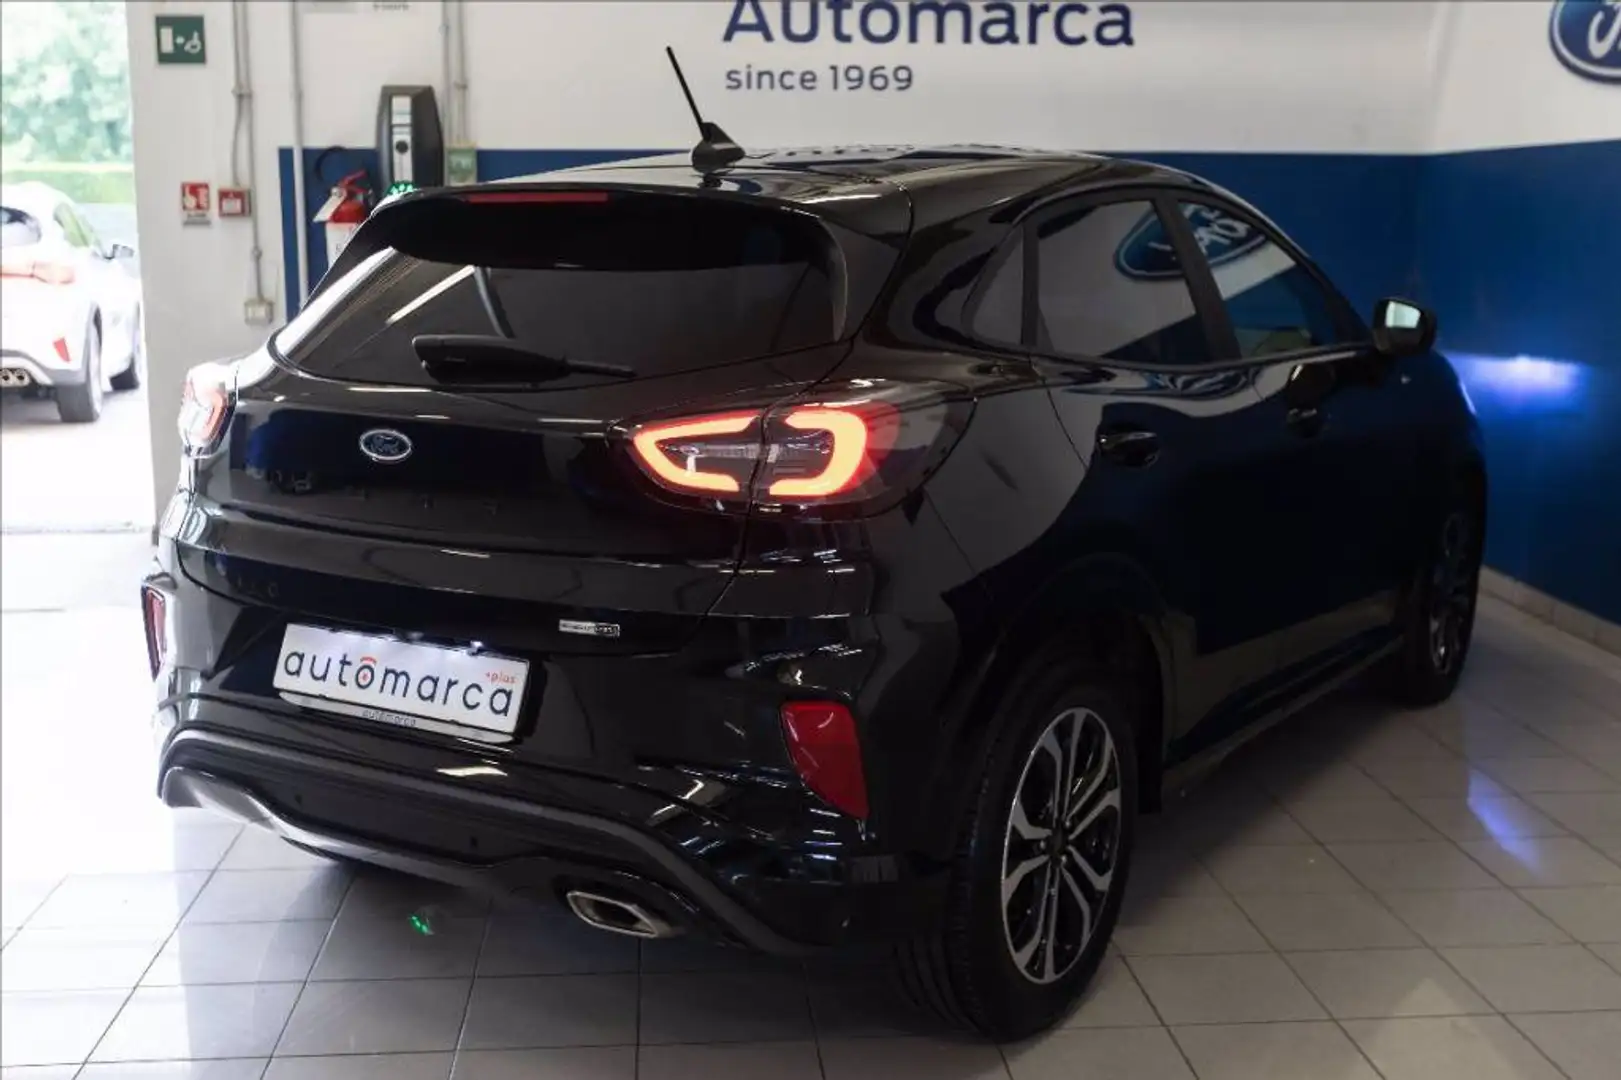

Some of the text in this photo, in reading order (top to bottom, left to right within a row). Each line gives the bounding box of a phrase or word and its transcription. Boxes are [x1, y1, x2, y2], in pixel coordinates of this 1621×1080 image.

[723, 0, 1135, 47] Automarca
[725, 64, 914, 91] since 1969
